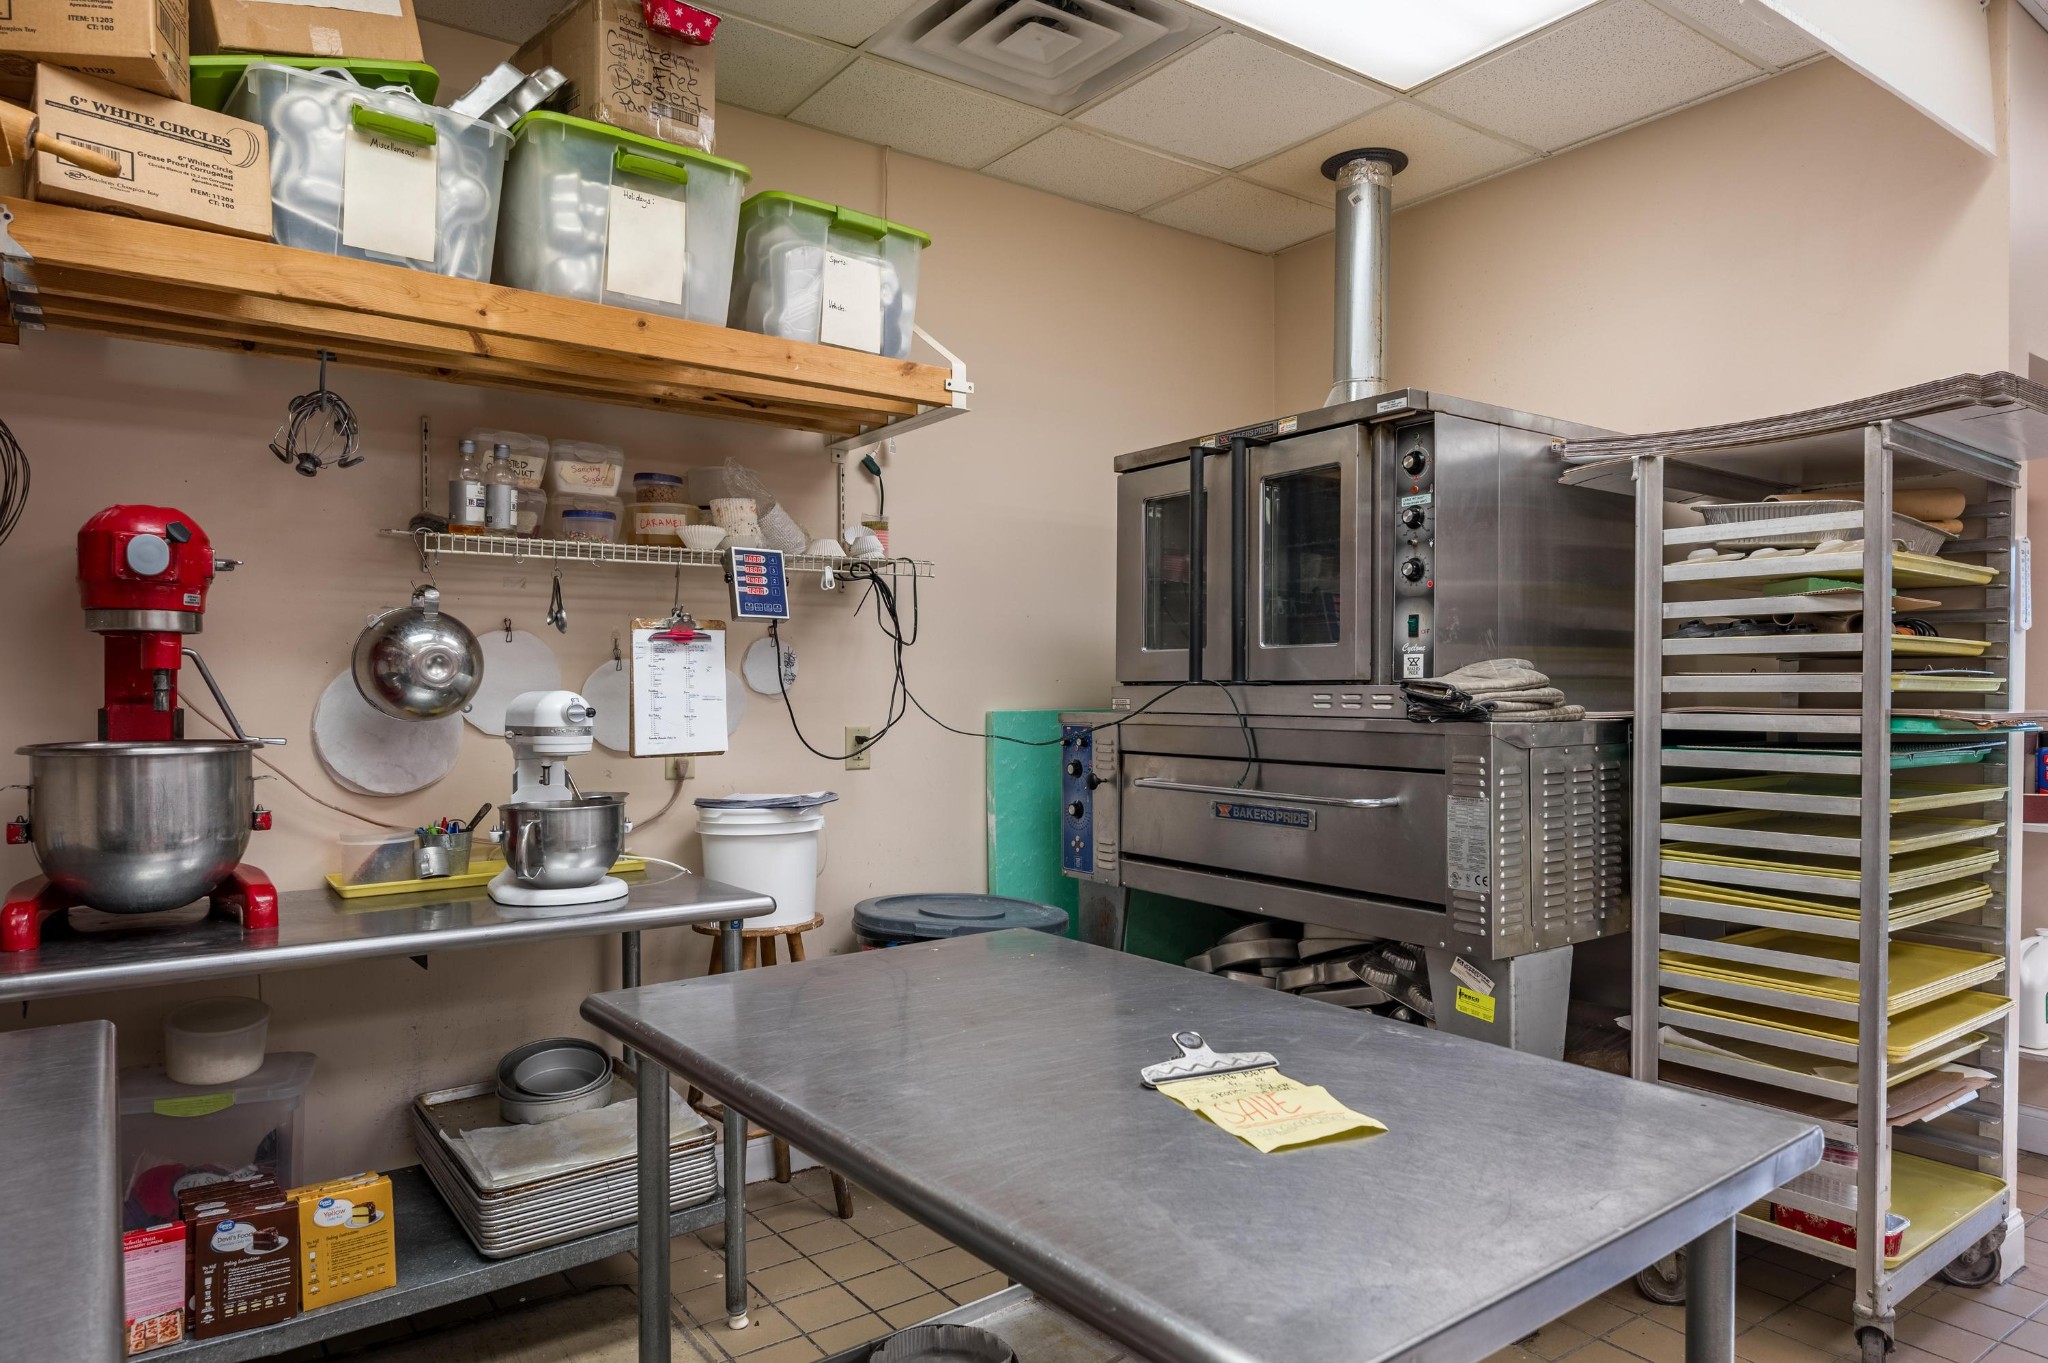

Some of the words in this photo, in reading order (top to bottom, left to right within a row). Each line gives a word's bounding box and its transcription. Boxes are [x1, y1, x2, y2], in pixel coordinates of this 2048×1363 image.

[68, 14, 90, 22] ITEM:
[91, 16, 114, 24] 11203
[619, 15, 644, 31] FOCUS
[607, 29, 692, 80] Gluten
[607, 64, 708, 113] Dessert
[652, 66, 702, 97] Free
[91, 100, 156, 128] WHITE
[159, 120, 232, 149] CIRCLES
[369, 137, 419, 158] Miscellaneous:
[137, 151, 166, 163] Grease
[166, 158, 189, 169] Proof
[189, 163, 234, 181] Corrugated
[187, 157, 210, 168] White
[211, 164, 234, 175] Circle
[88, 175, 115, 186] Southern
[116, 182, 146, 194] Champion
[208, 177, 234, 188] Corrugado
[190, 187, 212, 198] ITEM:
[212, 193, 235, 204] 11203
[623, 189, 655, 209] Holidays:
[208, 199, 220, 207] CT:
[221, 202, 235, 210] 100
[1255, 424, 1274, 436] PRIDE
[570, 464, 601, 479] Sanding
[581, 474, 606, 485] Sugar
[1402, 643, 1426, 654] Cyclone
[1233, 806, 1275, 820] BAKERS
[1275, 810, 1308, 825] PRIDE
[1213, 1092, 1302, 1125] SAVE
[323, 1207, 347, 1218] Yellow
[217, 1234, 237, 1244] Devil's
